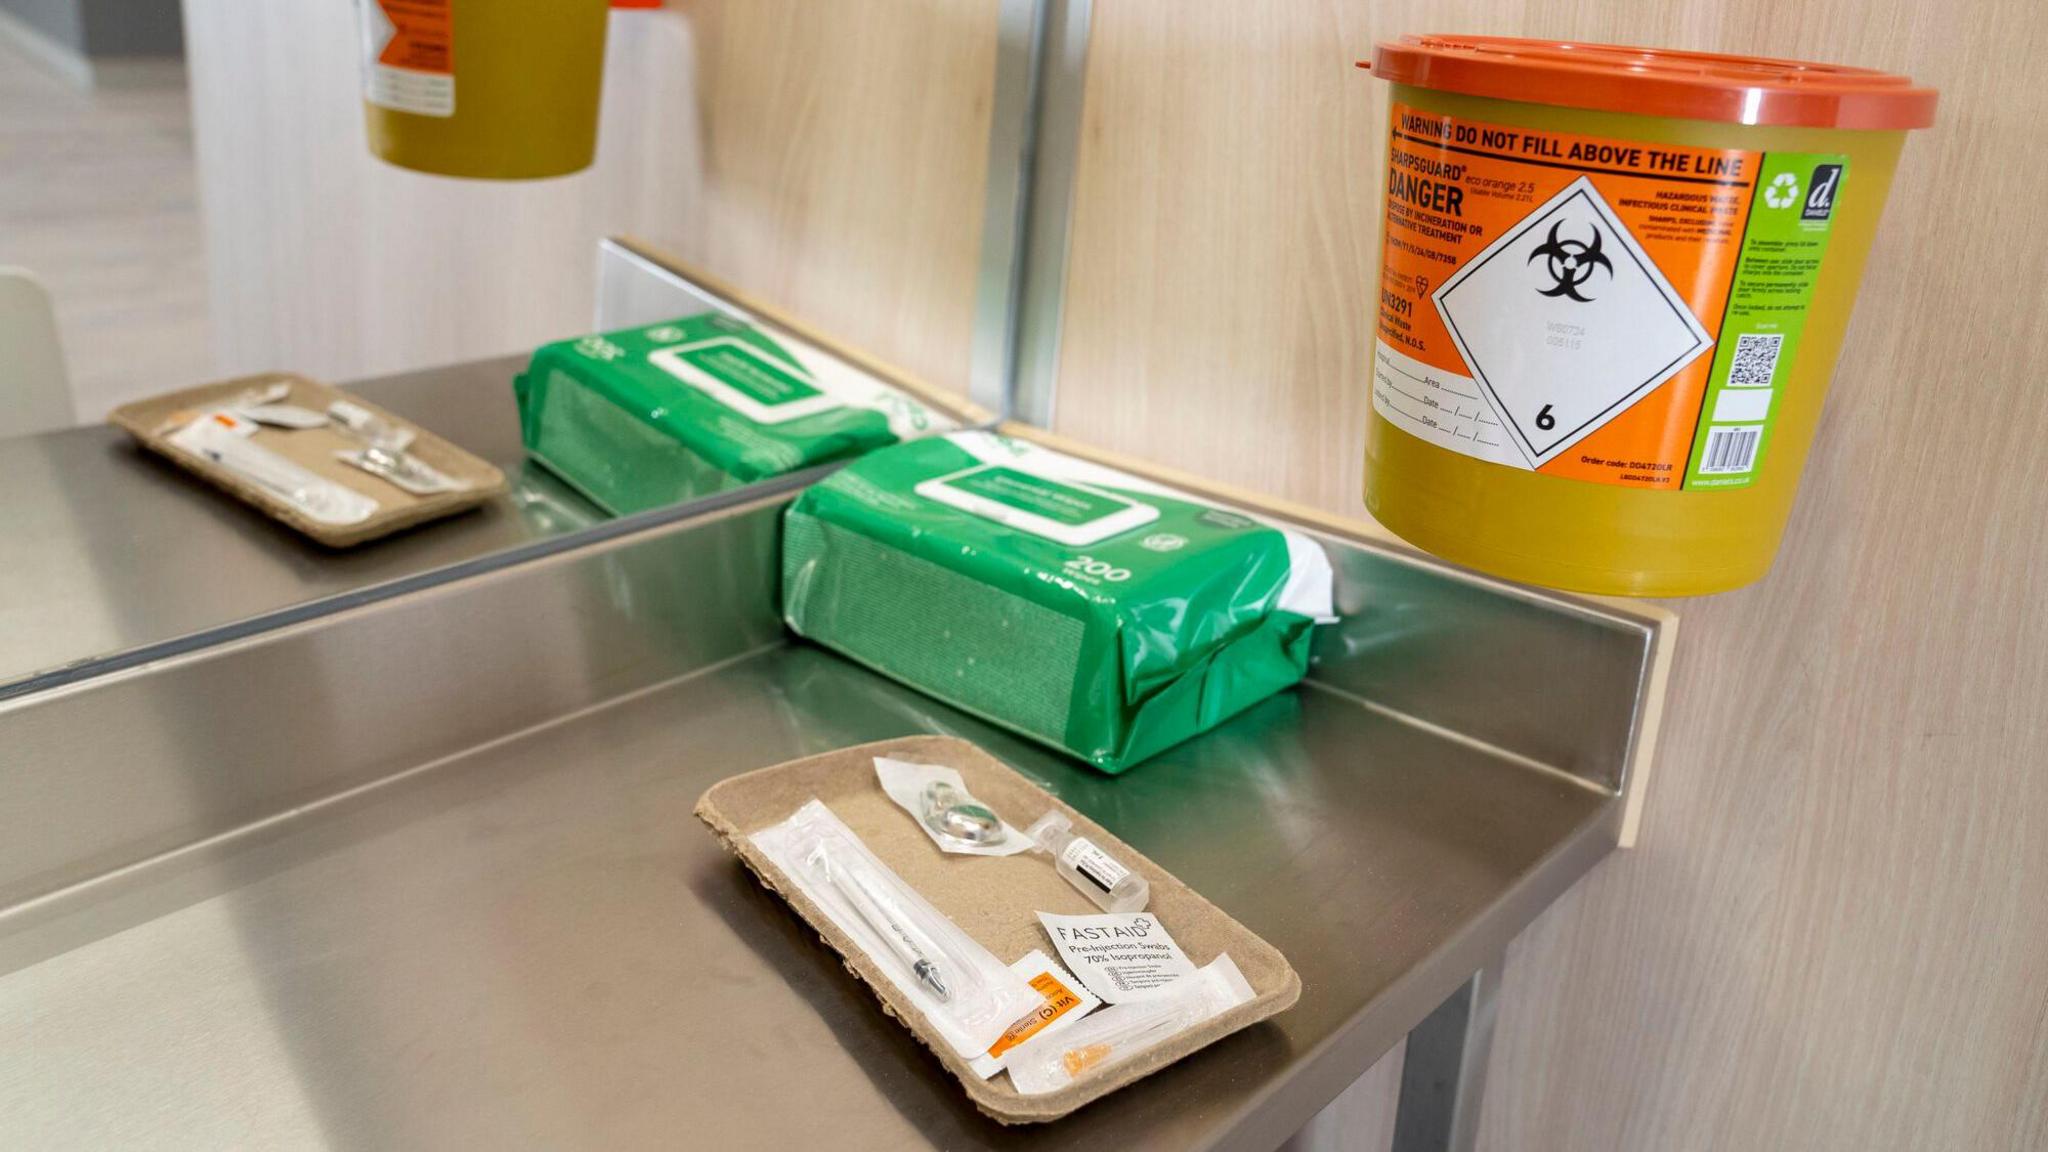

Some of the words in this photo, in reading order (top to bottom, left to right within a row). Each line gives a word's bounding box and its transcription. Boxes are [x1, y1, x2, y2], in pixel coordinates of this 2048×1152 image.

[1401, 113, 1452, 139] WARNING
[1456, 125, 1477, 144] DO
[1482, 129, 1518, 151] NOT
[1522, 135, 1563, 158] FILL
[1568, 142, 1641, 167] ABOVE
[1649, 151, 1689, 173] THE
[1695, 156, 1743, 177] LINE
[1465, 175, 1481, 186] eco
[1482, 178, 1516, 192] orange
[1518, 181, 1536, 193] 2.5
[1389, 168, 1464, 217] DANGER
[1415, 209, 1467, 232] INCINERATION
[1469, 224, 1482, 236] OR
[1418, 224, 1463, 245] TREATMENT
[1405, 335, 1426, 352] N.O.S.
[1424, 376, 1440, 389] Area
[1423, 395, 1439, 408] Date
[1422, 415, 1438, 428] Date
[1536, 404, 1555, 431] 6
[1581, 455, 1604, 466] Order
[1606, 459, 1627, 468] code:
[1064, 555, 1132, 582] 200
[1069, 943, 1136, 953] Pre-Injection
[1138, 942, 1170, 951] Swabs
[1084, 955, 1109, 964] 70%
[1111, 952, 1174, 962] Isopropanol
[1058, 995, 1074, 1009] Vit
[1039, 1004, 1058, 1020] (C)
